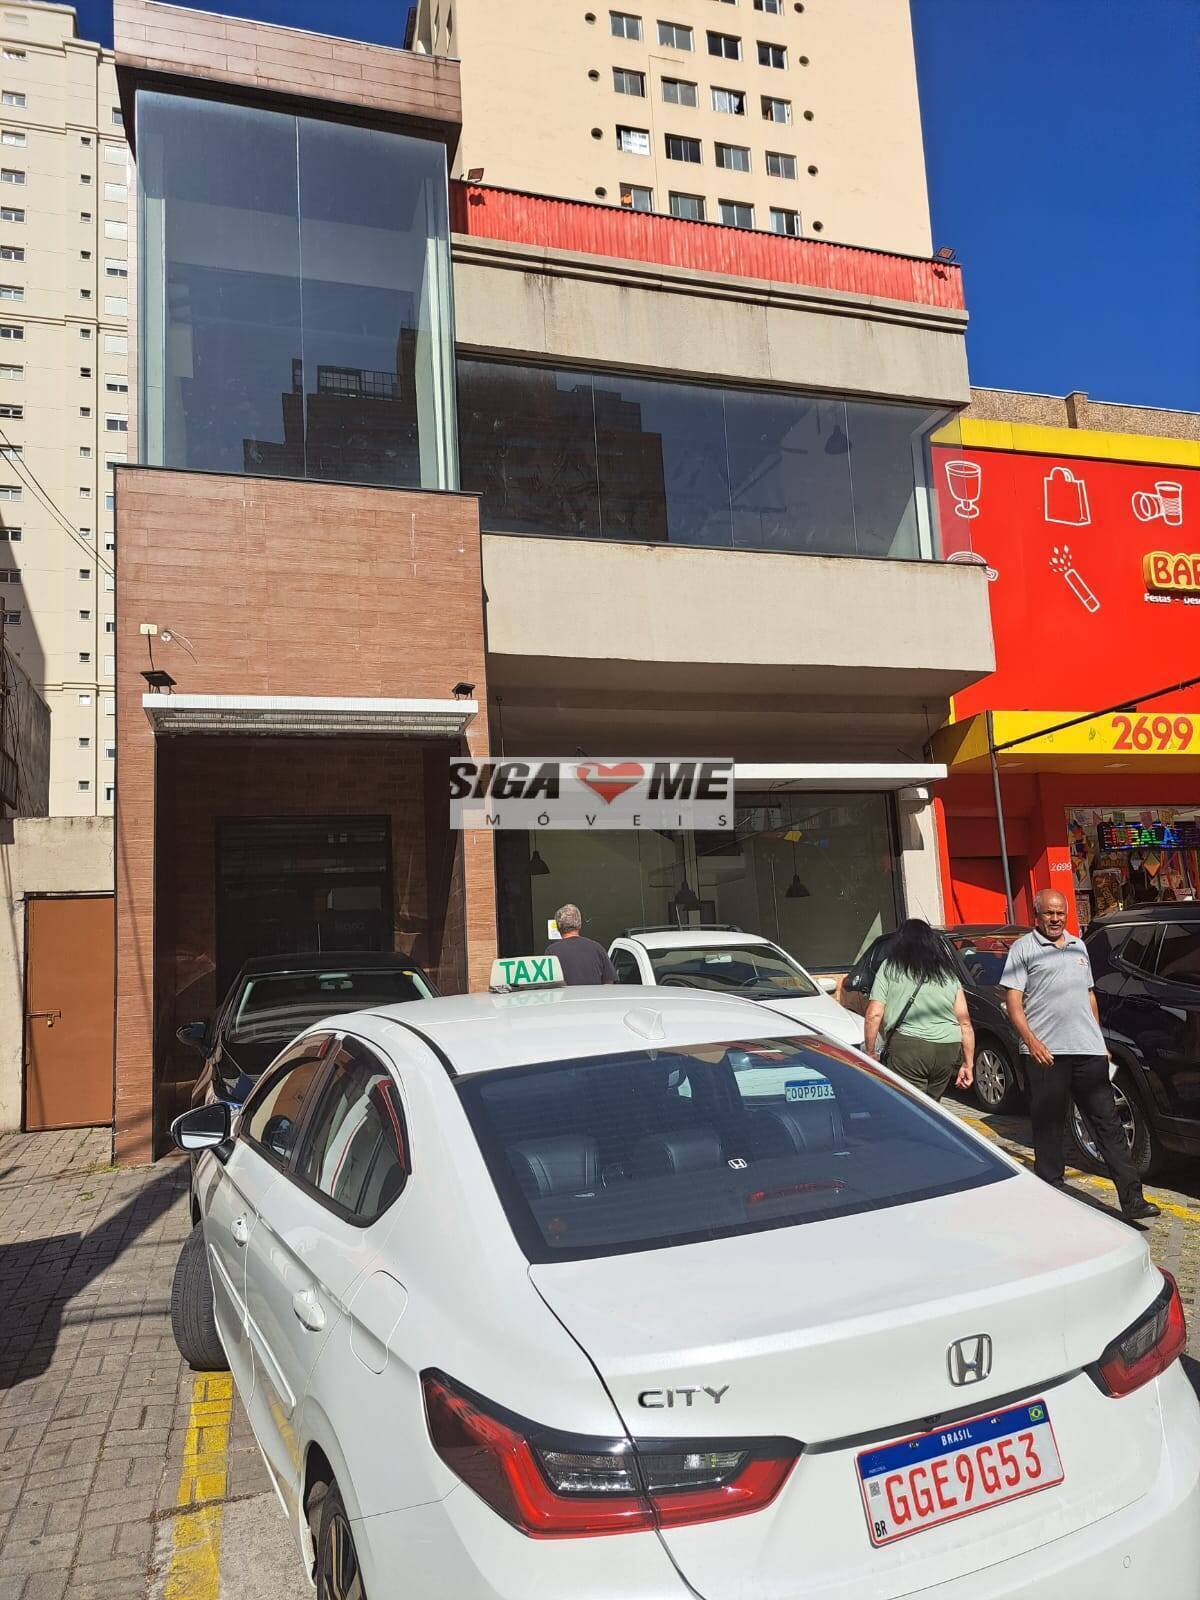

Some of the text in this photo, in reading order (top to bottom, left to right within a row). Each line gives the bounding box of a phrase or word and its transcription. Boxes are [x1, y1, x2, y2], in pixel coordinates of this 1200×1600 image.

[1111, 715, 1194, 751] 2699
[499, 957, 554, 985] TAXI
[638, 1384, 730, 1409] CITY
[940, 1427, 973, 1447] BRASIL
[884, 1432, 1042, 1526] GGE9G53
[874, 1520, 888, 1538] BR
